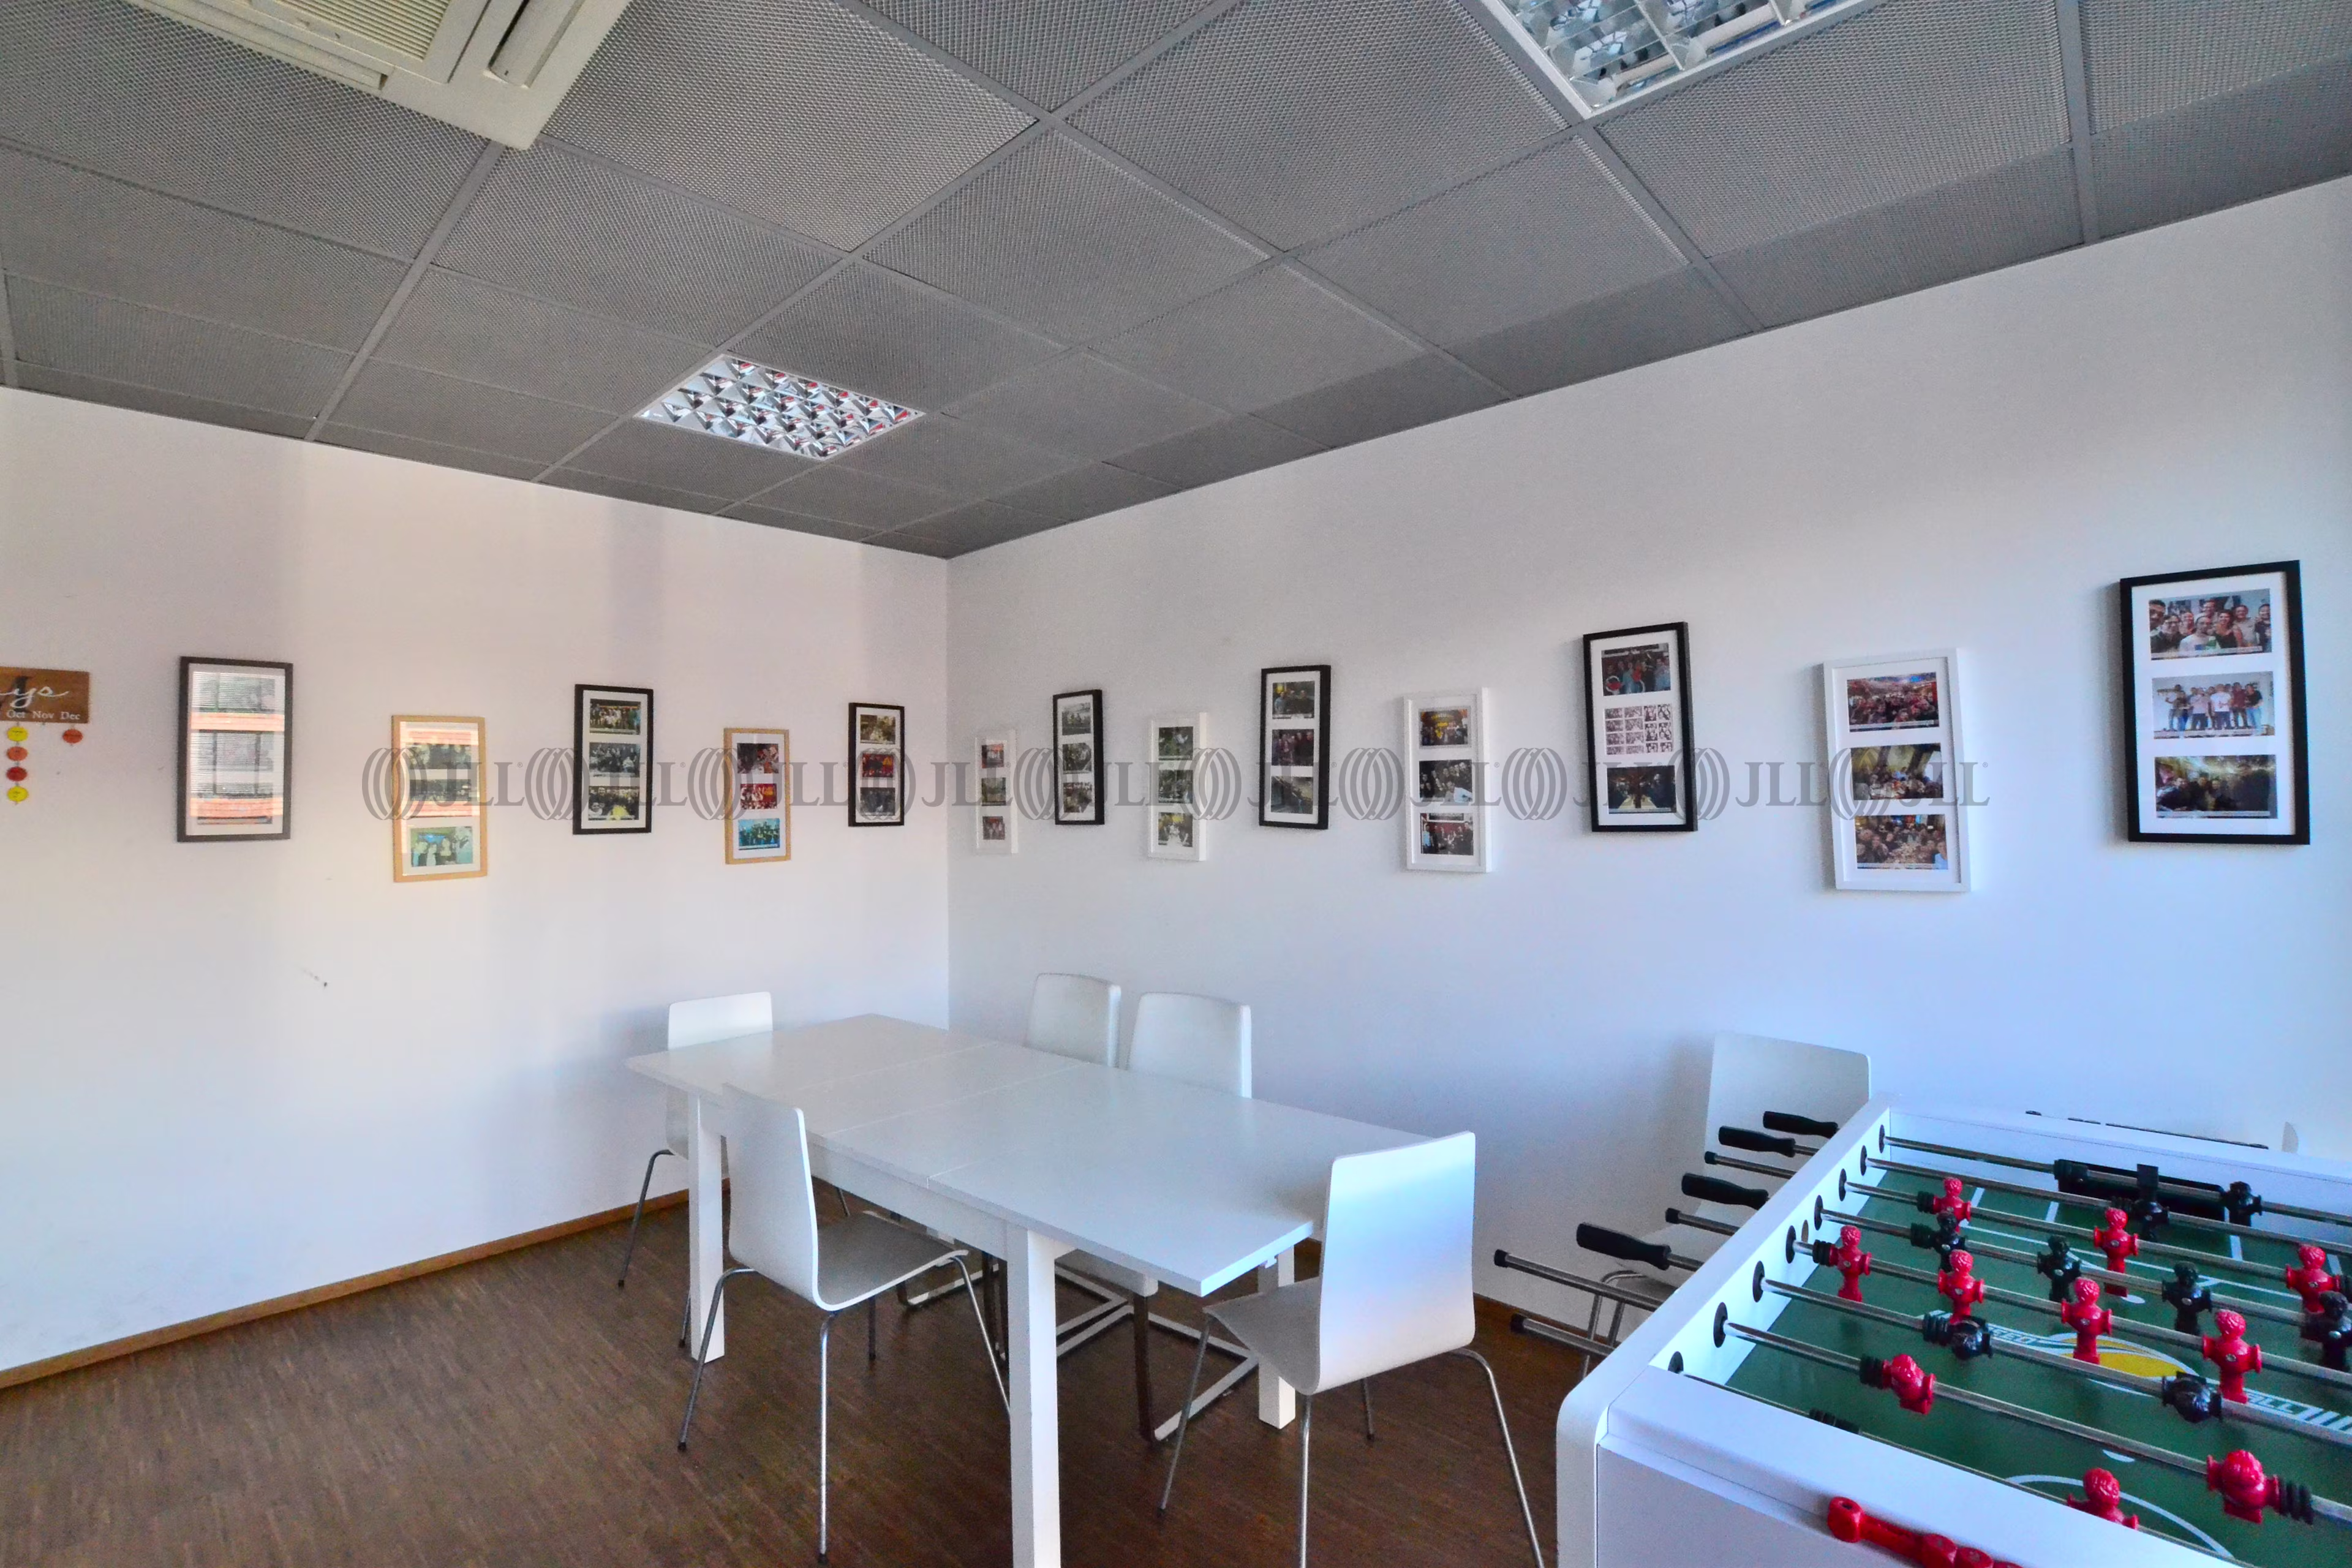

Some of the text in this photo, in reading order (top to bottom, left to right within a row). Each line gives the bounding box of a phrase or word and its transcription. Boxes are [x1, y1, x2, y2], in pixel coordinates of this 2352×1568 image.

[6, 710, 81, 720] Oct Nov Dec
